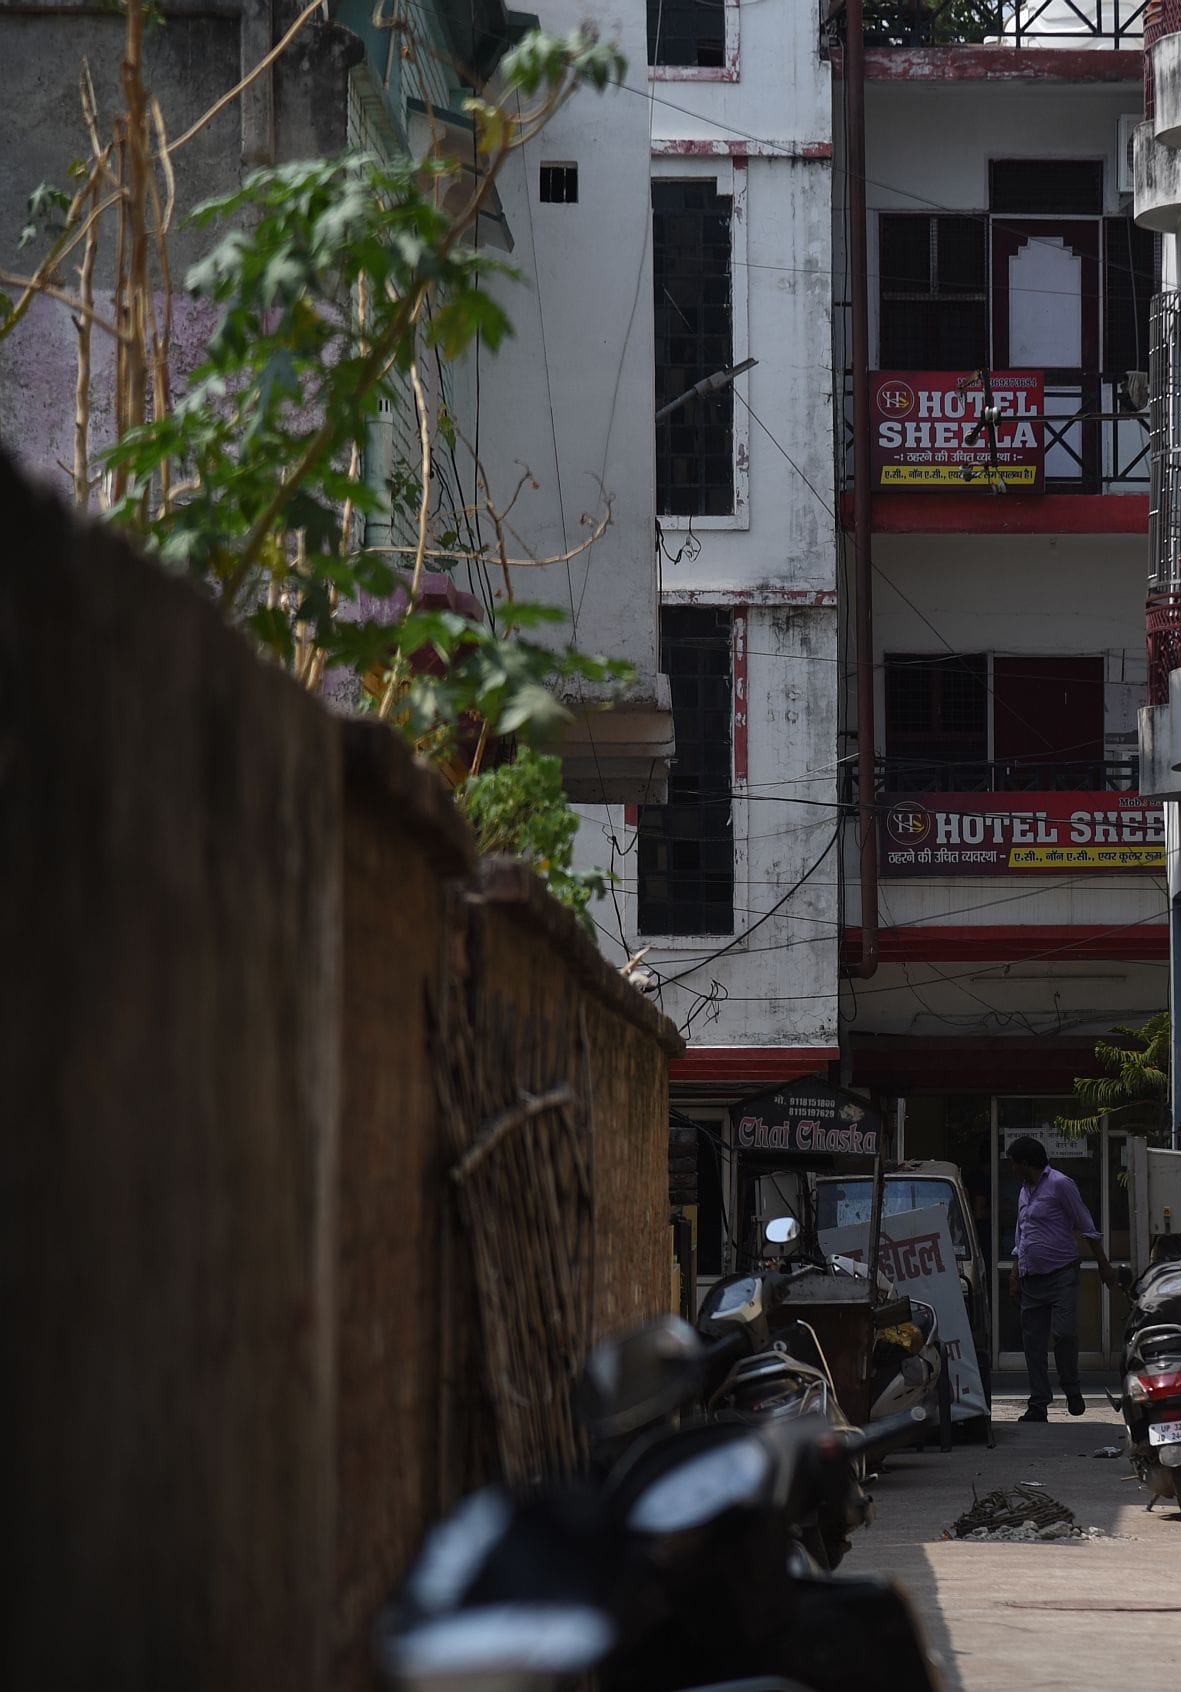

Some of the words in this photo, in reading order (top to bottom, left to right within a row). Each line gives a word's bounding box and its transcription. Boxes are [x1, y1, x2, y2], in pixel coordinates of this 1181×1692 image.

[985, 378, 1037, 387] 369373684
[918, 391, 1037, 418] HOTEL
[878, 421, 1038, 449] SHEELA
[934, 450, 948, 462] की
[950, 450, 974, 462] उचित
[936, 812, 1059, 845] HOTEL
[887, 848, 915, 864] ठहरने
[917, 848, 932, 863] की
[934, 847, 959, 863] उचित
[961, 850, 997, 863] व्यवस्था
[738, 1116, 790, 1149] Chai
[795, 1119, 877, 1154] Chaska
[879, 1231, 945, 1283] होटल
[1160, 1424, 1170, 1432] UP
